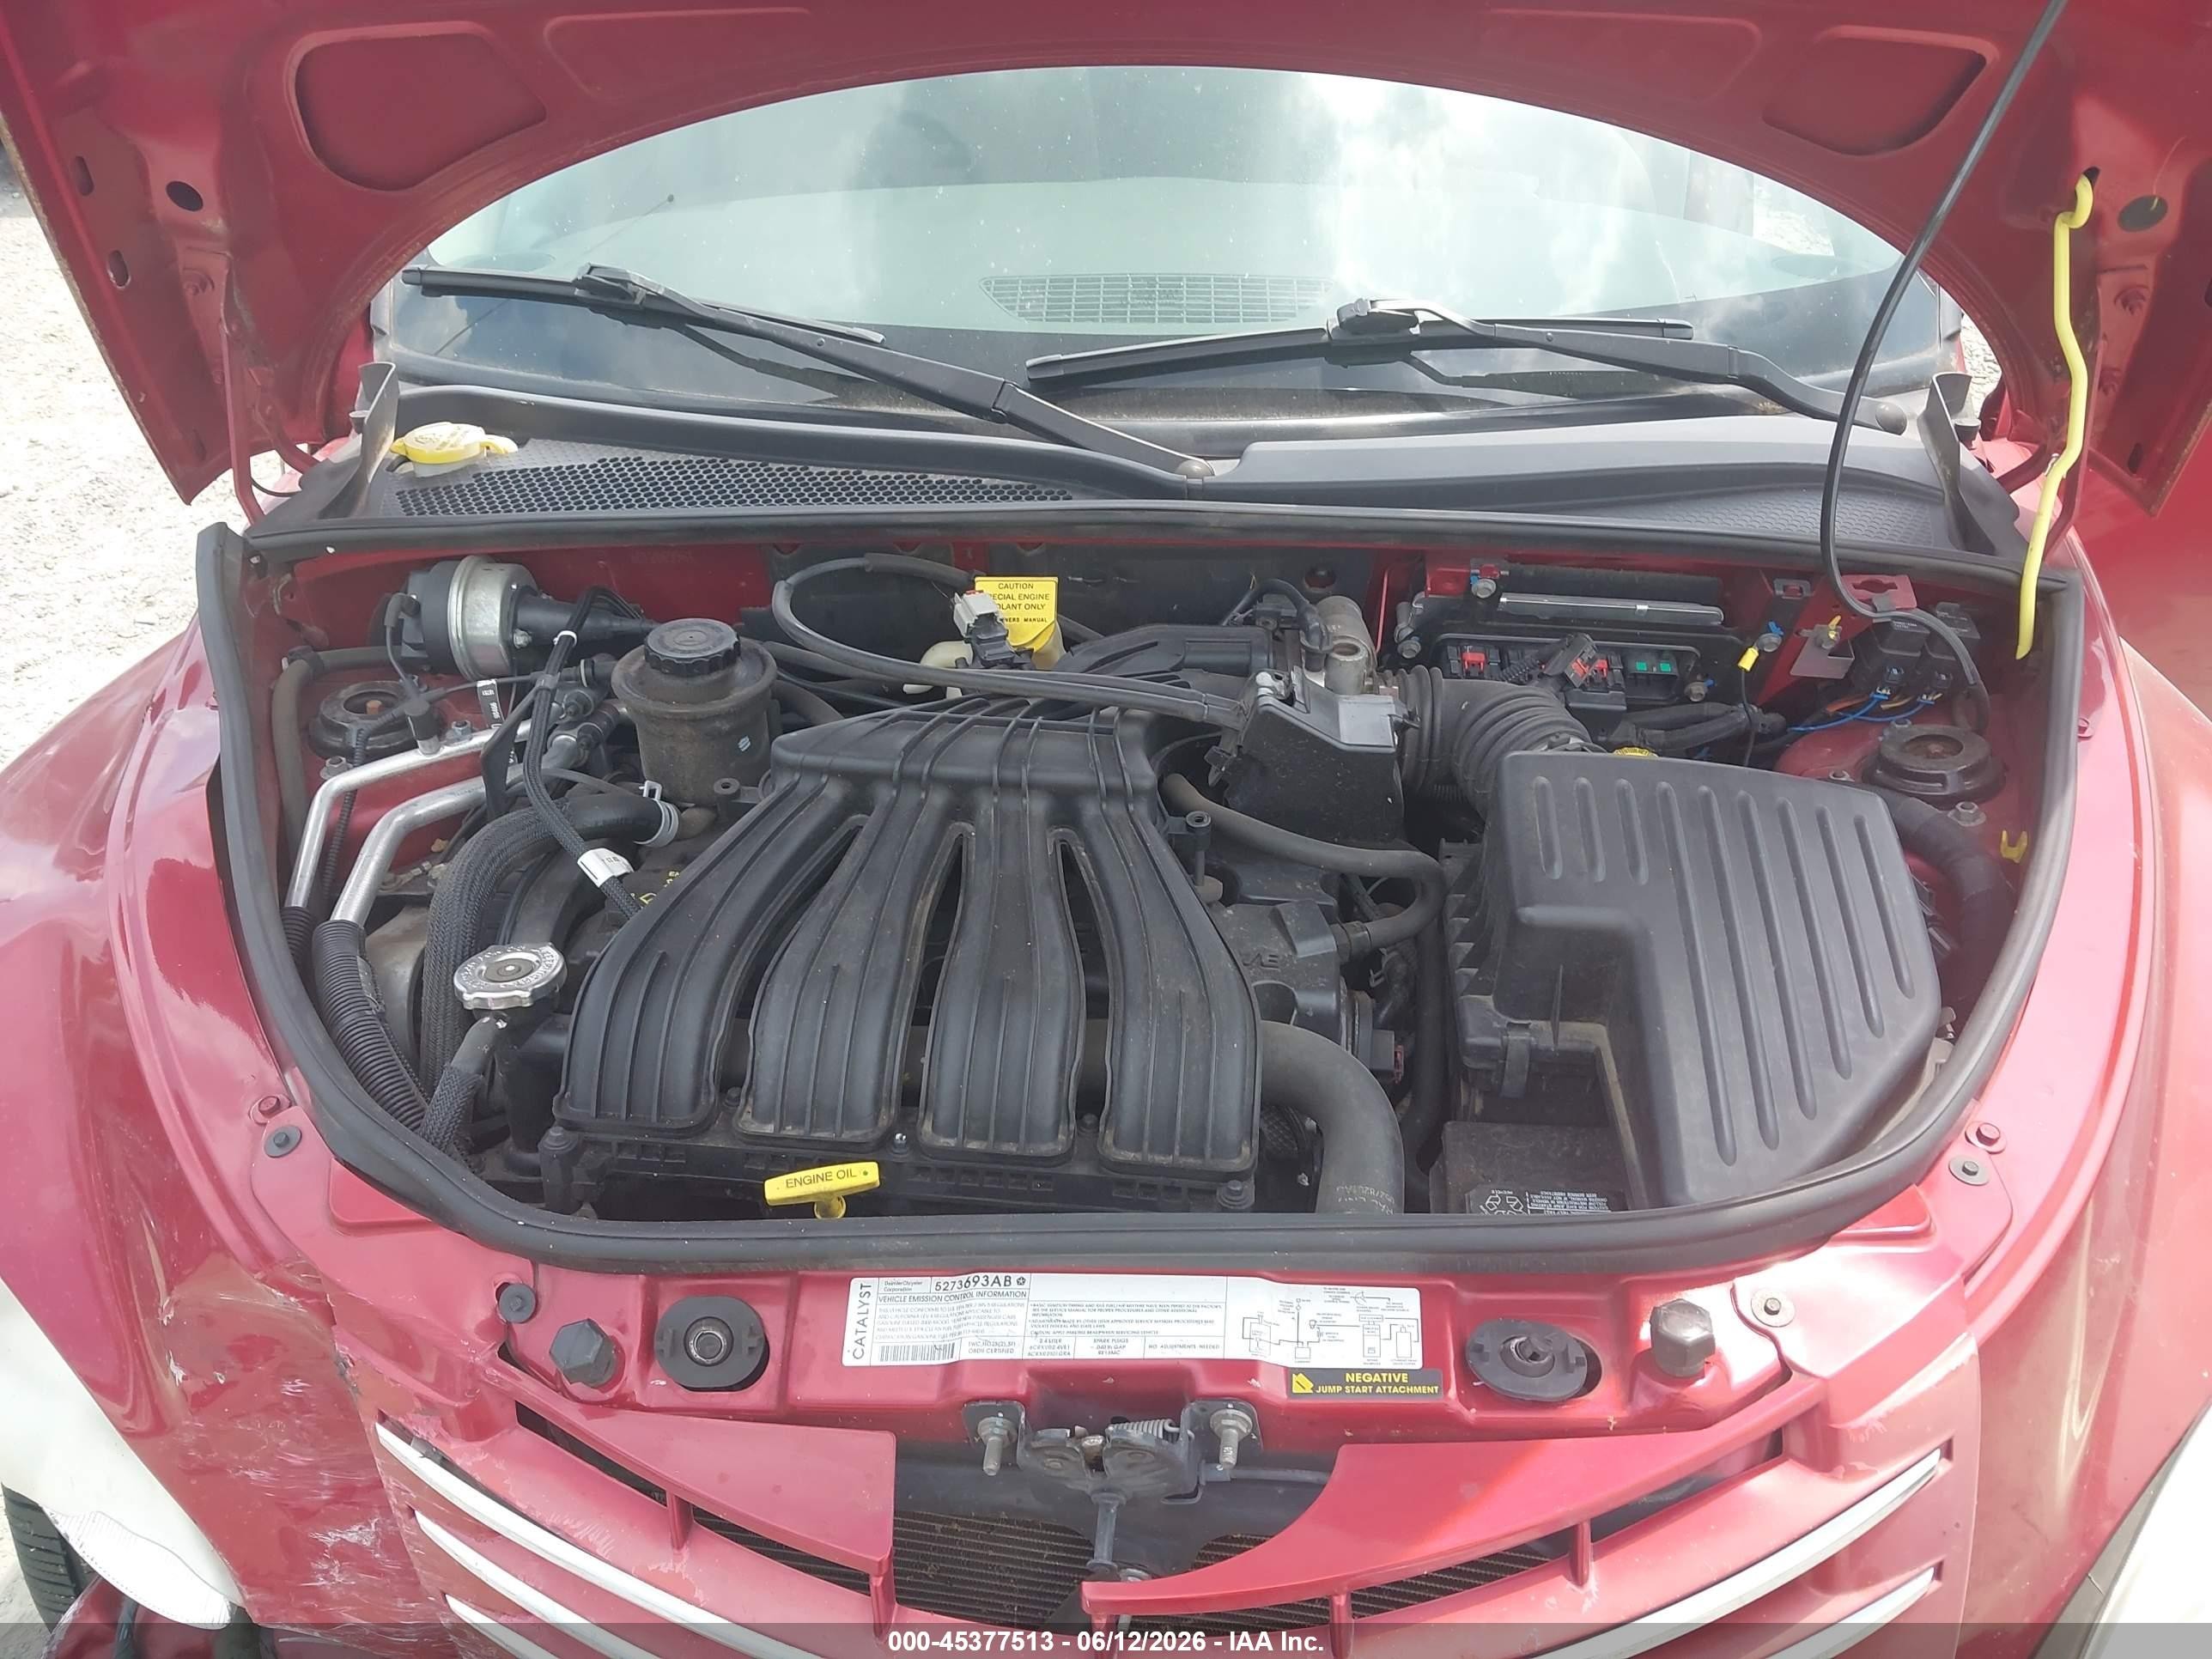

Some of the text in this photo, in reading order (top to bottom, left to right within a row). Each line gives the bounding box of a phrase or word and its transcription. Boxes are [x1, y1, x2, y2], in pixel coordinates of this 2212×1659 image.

[786, 1169, 857, 1188] ENGINE OIL
[935, 1275, 1012, 1291] 5273693AB
[908, 1294, 942, 1303] EMISSION
[945, 1292, 974, 1302] CONTROL
[853, 1284, 872, 1359] CATALYST
[1346, 1372, 1408, 1383] NEGATIVE
[1316, 1385, 1439, 1394] JUMP START ATTACHMENT
